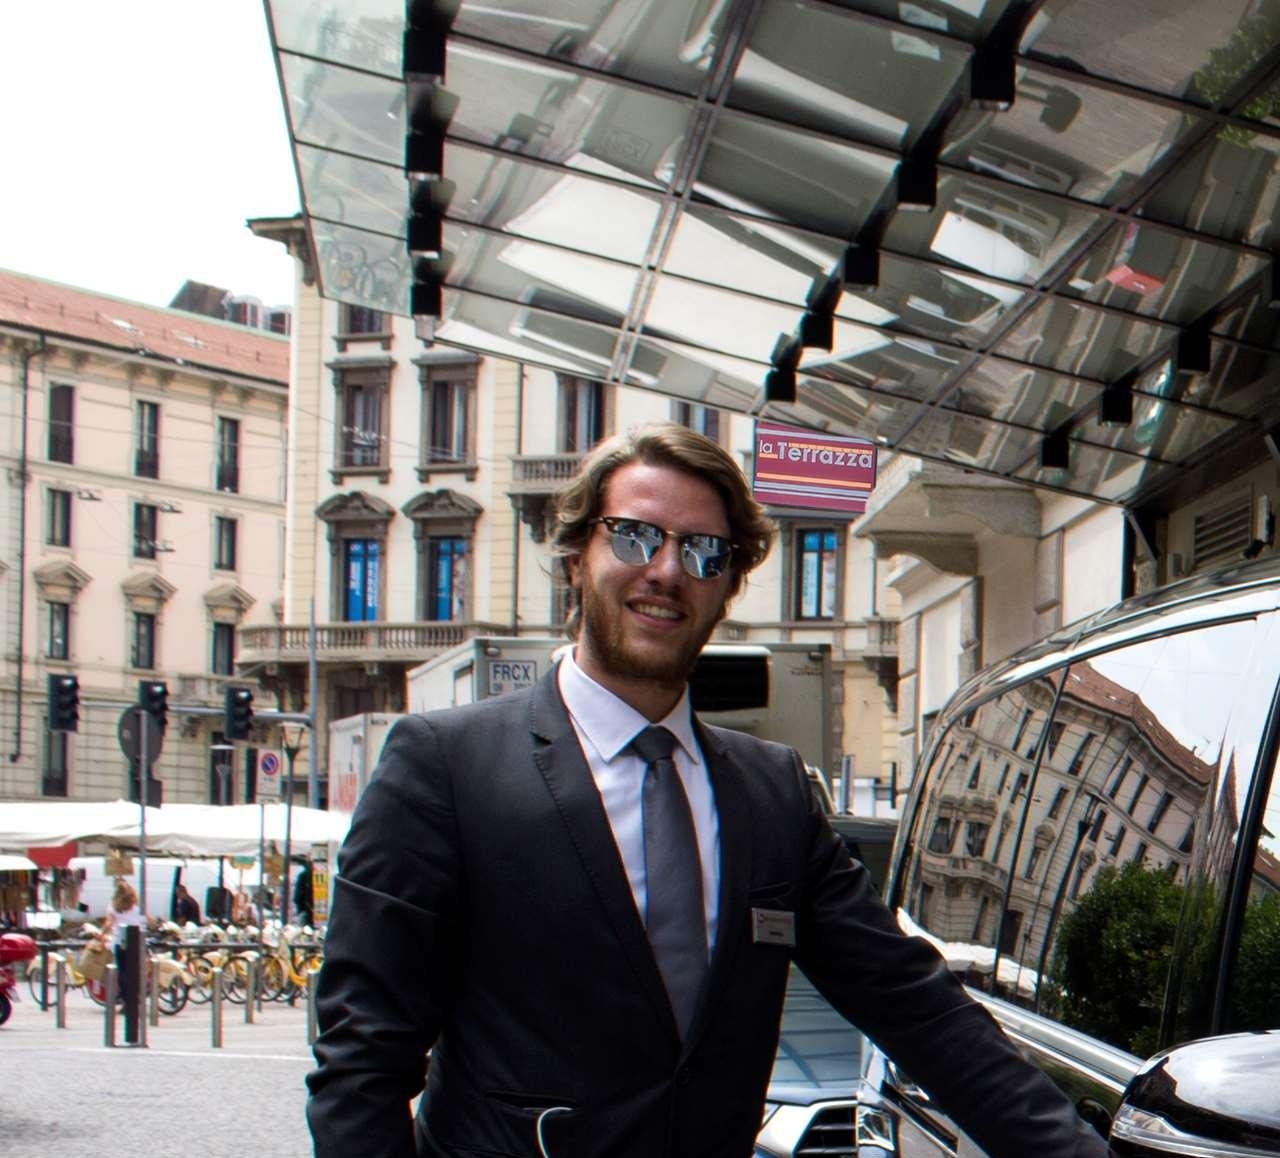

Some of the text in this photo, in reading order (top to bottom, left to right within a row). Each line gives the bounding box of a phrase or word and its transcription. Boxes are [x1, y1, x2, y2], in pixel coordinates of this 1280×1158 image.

[760, 440, 873, 468] la Terrazza
[493, 664, 531, 680] FRCX
